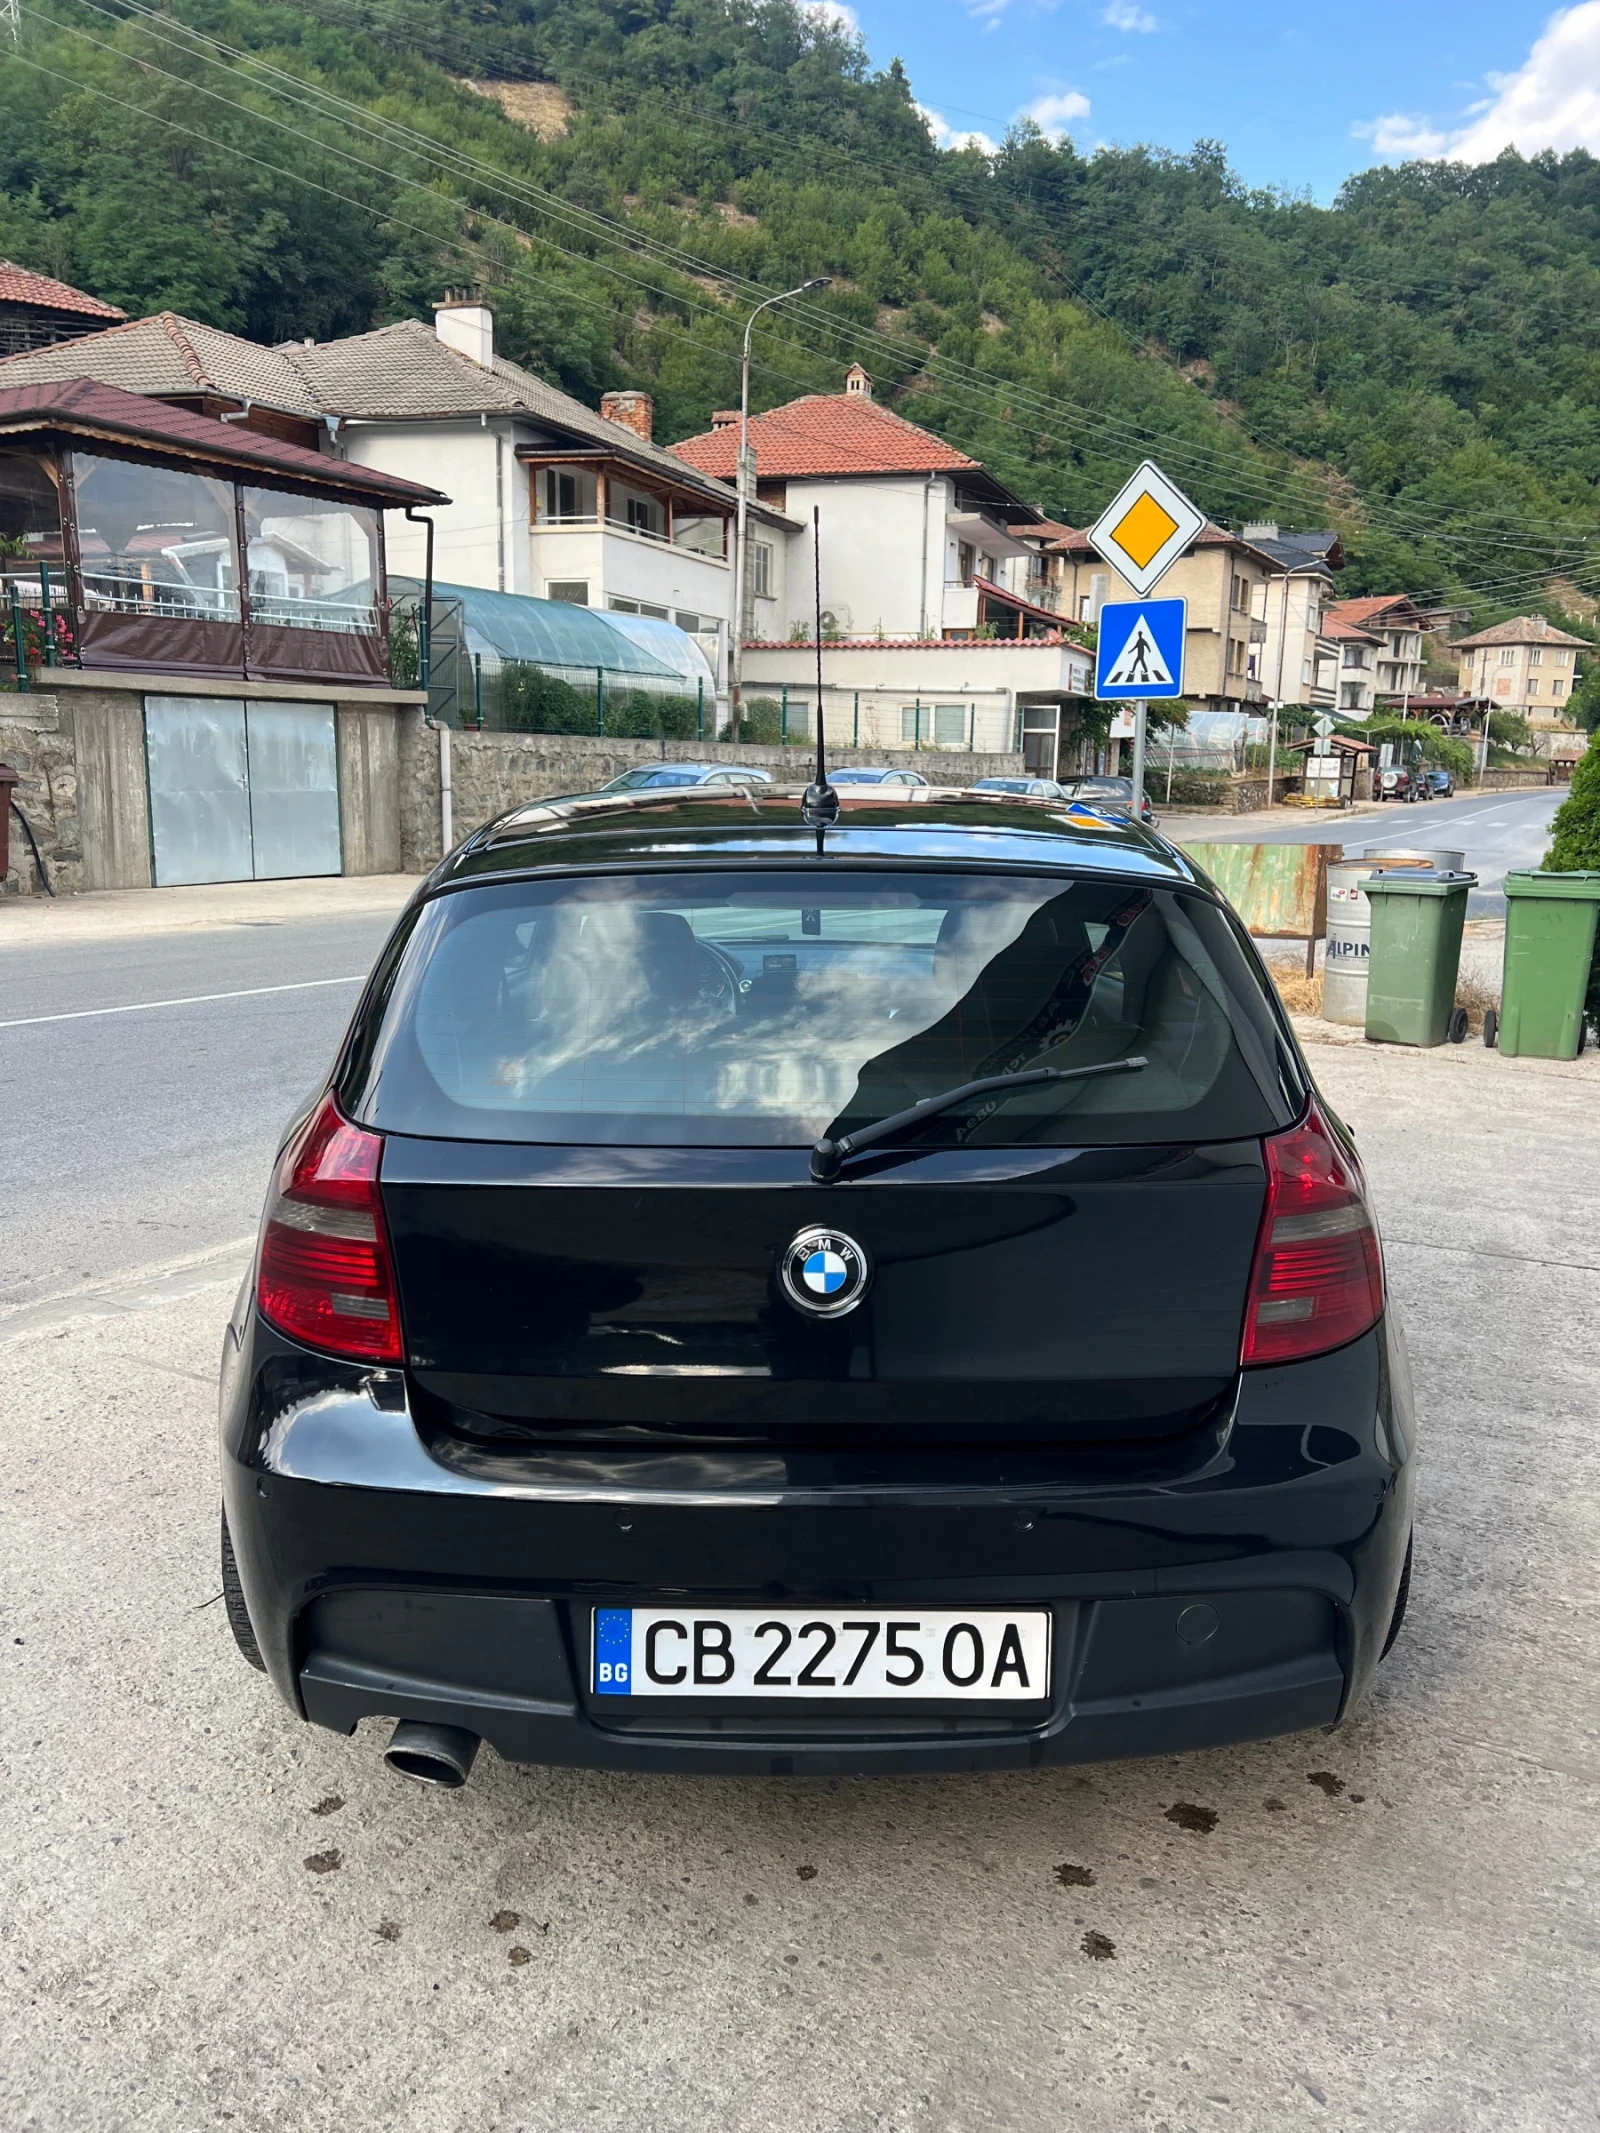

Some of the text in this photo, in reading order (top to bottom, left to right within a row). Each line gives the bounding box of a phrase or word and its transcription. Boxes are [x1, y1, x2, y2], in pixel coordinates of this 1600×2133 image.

[797, 1239, 854, 1261] BMW
[646, 1621, 734, 1684] CB
[754, 1622, 923, 1686] 2275
[600, 1663, 627, 1682] BG
